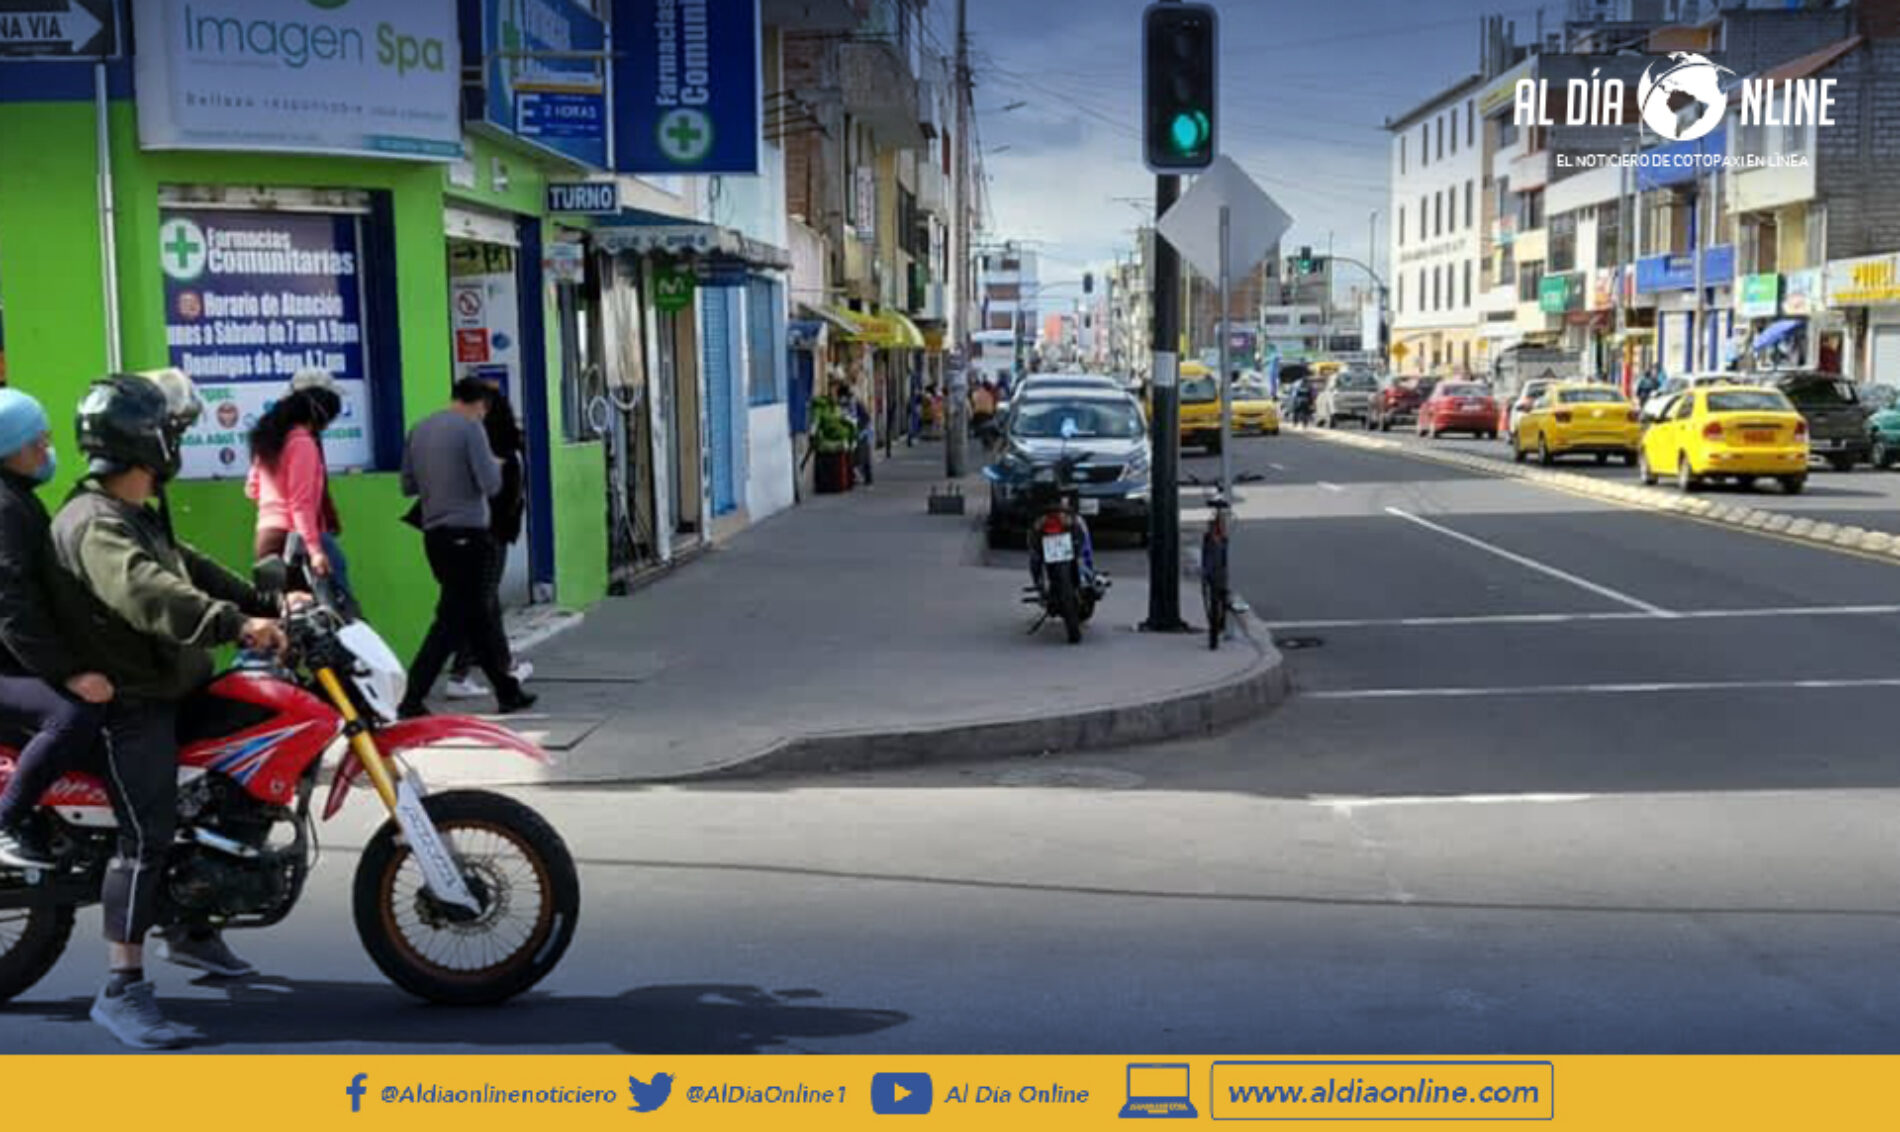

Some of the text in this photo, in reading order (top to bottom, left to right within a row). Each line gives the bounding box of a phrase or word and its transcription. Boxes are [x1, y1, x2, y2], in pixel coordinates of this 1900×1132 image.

[0, 15, 62, 38] NA VIA
[184, 4, 444, 75] Imagen Spa
[550, 186, 612, 210] TURNO
[207, 227, 291, 250] Farmacias
[208, 249, 354, 275] Comunitarias
[203, 292, 259, 317] Horario
[261, 293, 279, 317] de
[268, 320, 285, 344] de
[182, 352, 253, 379] Domingos
[255, 350, 271, 374] de
